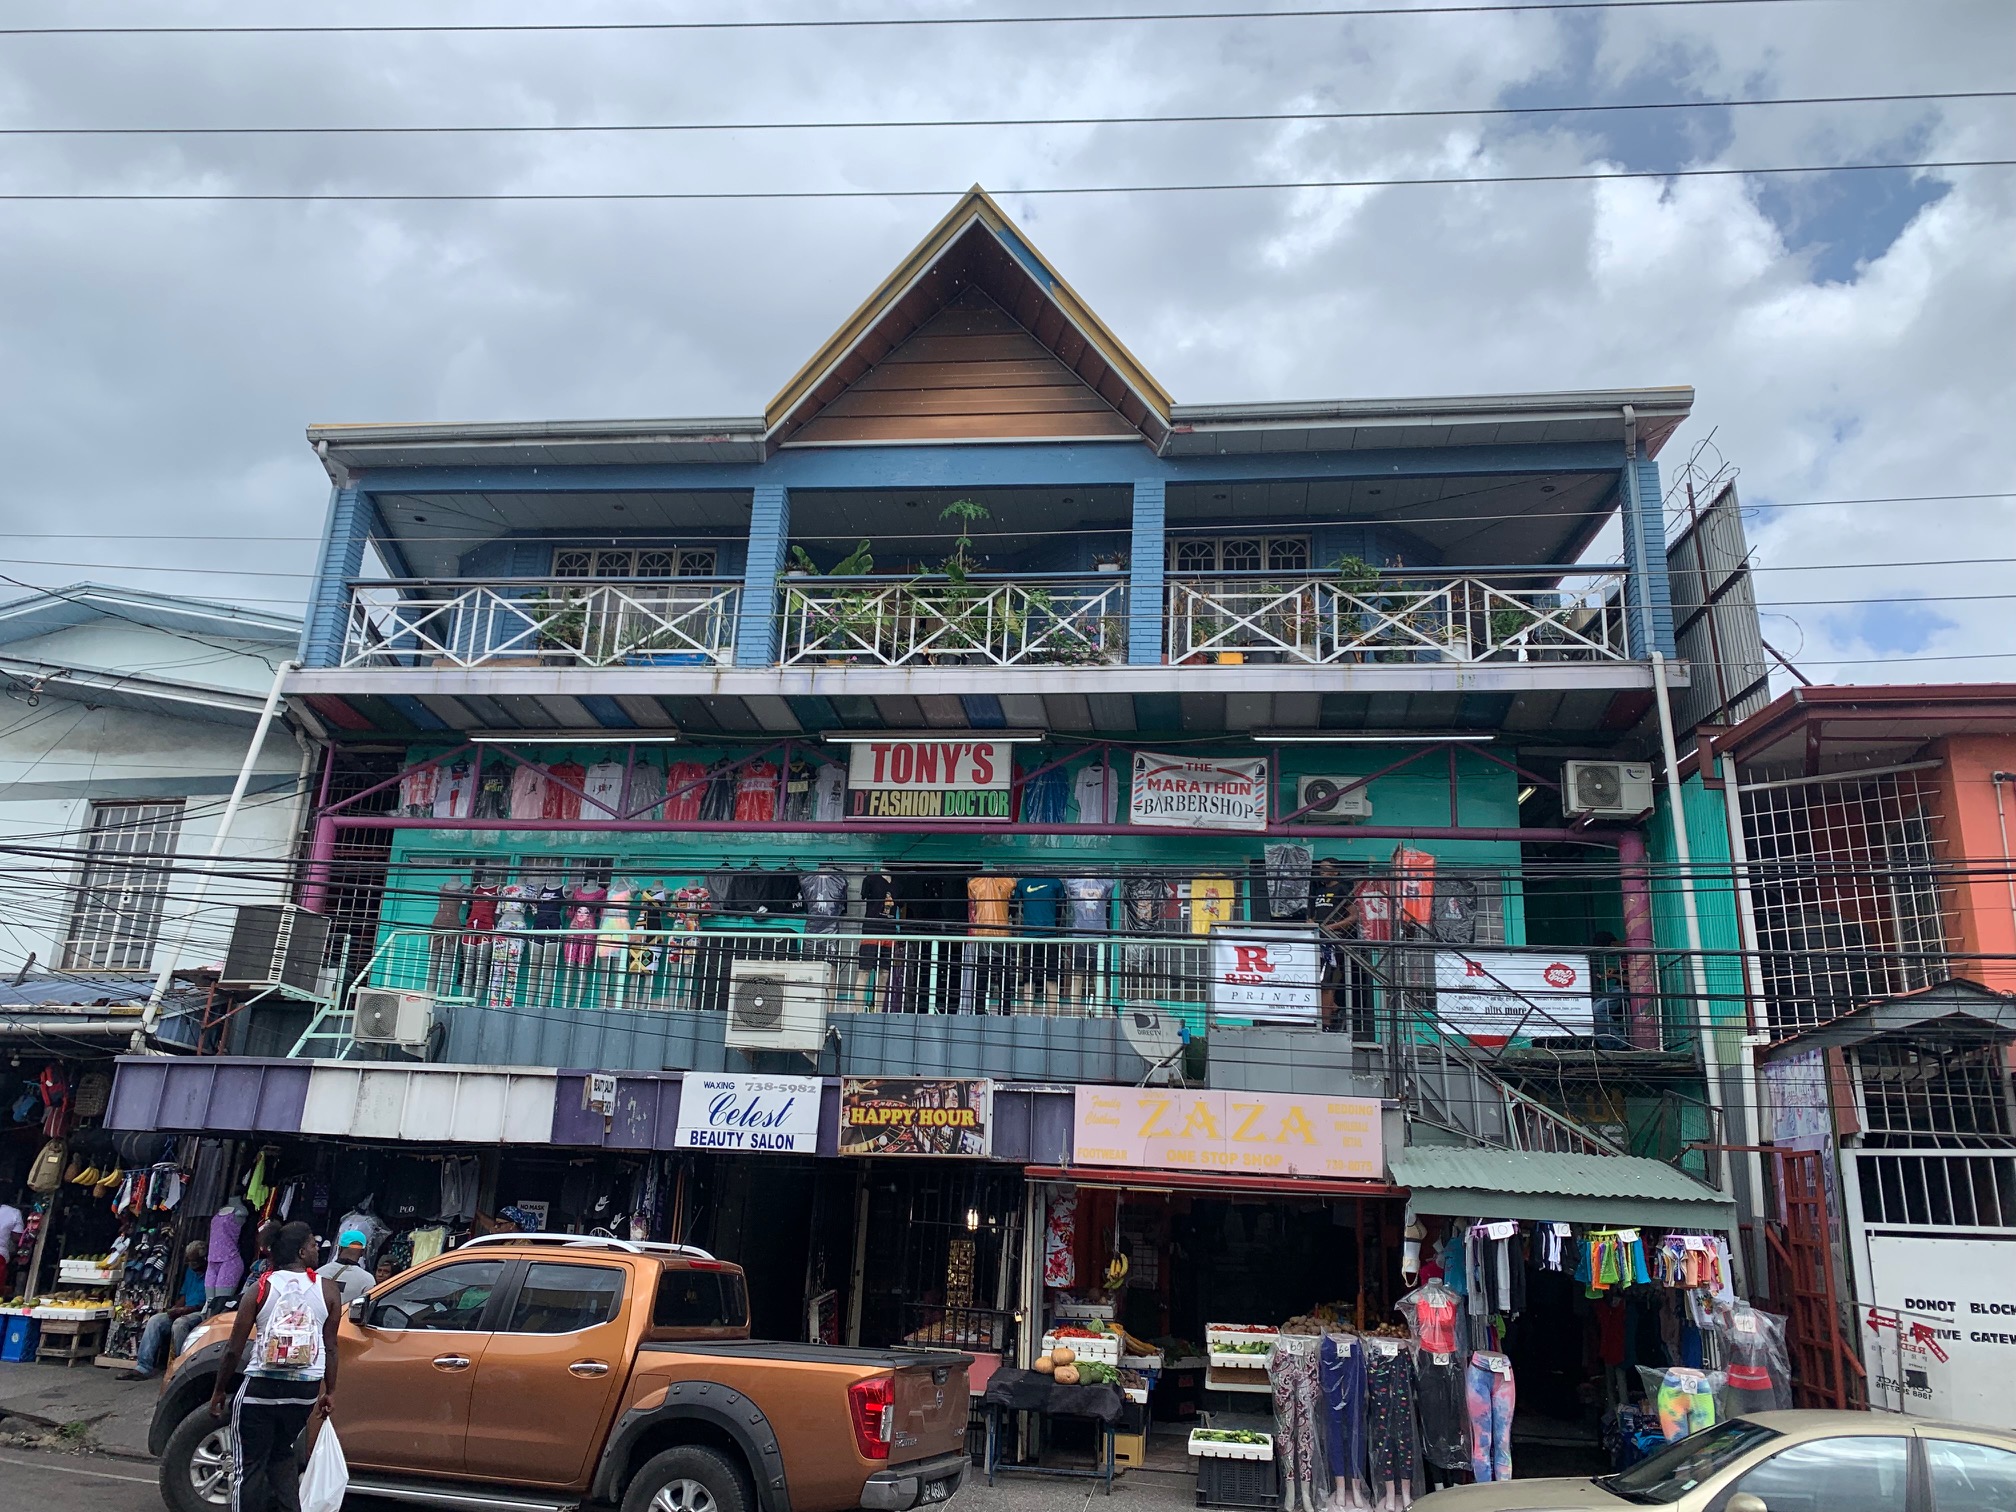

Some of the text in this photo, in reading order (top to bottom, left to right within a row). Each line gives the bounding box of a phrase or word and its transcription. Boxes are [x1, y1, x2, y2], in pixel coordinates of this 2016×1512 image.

[871, 743, 993, 784] TONY'S
[1185, 762, 1213, 772] THE
[1147, 778, 1251, 795] MARATHON
[853, 790, 868, 815] D'
[869, 790, 942, 816] FASHION
[944, 790, 1009, 816] DOCTOR
[1143, 794, 1254, 819] BARBERSHOP
[1224, 973, 1264, 985] RED
[1231, 991, 1311, 1002] PRINTS
[703, 1081, 817, 1094] WAXING 738-5982
[708, 1091, 795, 1128] Celest
[851, 1107, 976, 1127] HAPPY HOUR
[1327, 1103, 1374, 1116] BEDDING
[1136, 1099, 1321, 1145] ZAZA
[690, 1130, 795, 1150] BEAUTY SALON
[1077, 1147, 1128, 1161] FOOTWEAR
[1166, 1149, 1283, 1167] ONE STOP SHOP
[1492, 1224, 1509, 1236] 10
[1905, 1298, 1956, 1312] DONOT
